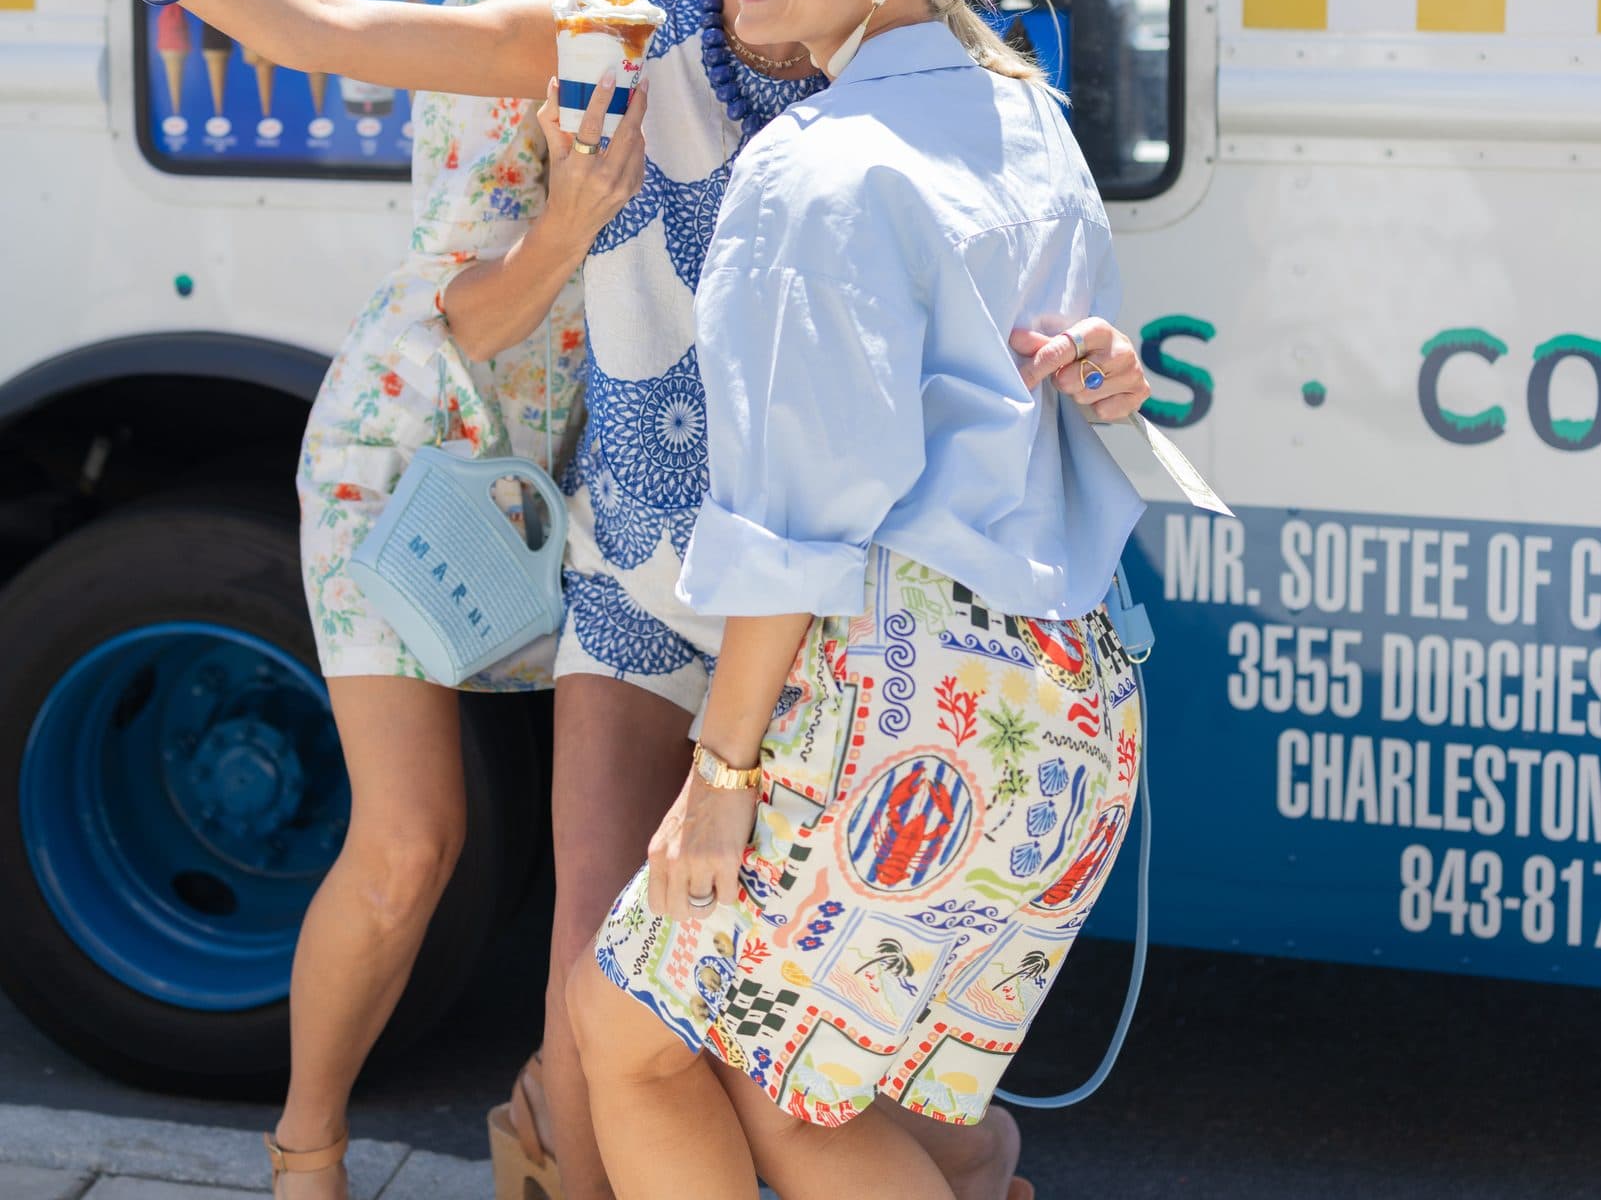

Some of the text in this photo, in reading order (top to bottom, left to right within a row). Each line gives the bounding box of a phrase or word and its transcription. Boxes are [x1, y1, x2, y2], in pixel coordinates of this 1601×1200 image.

[408, 535, 491, 638] MARNI
[1164, 513, 1261, 606] MR.
[1279, 519, 1469, 620] SOFTEE
[1486, 532, 1553, 626] OF
[1227, 621, 1363, 719] 3555
[1276, 728, 1601, 844] CHARLESTON
[1400, 843, 1601, 949] 843-81
